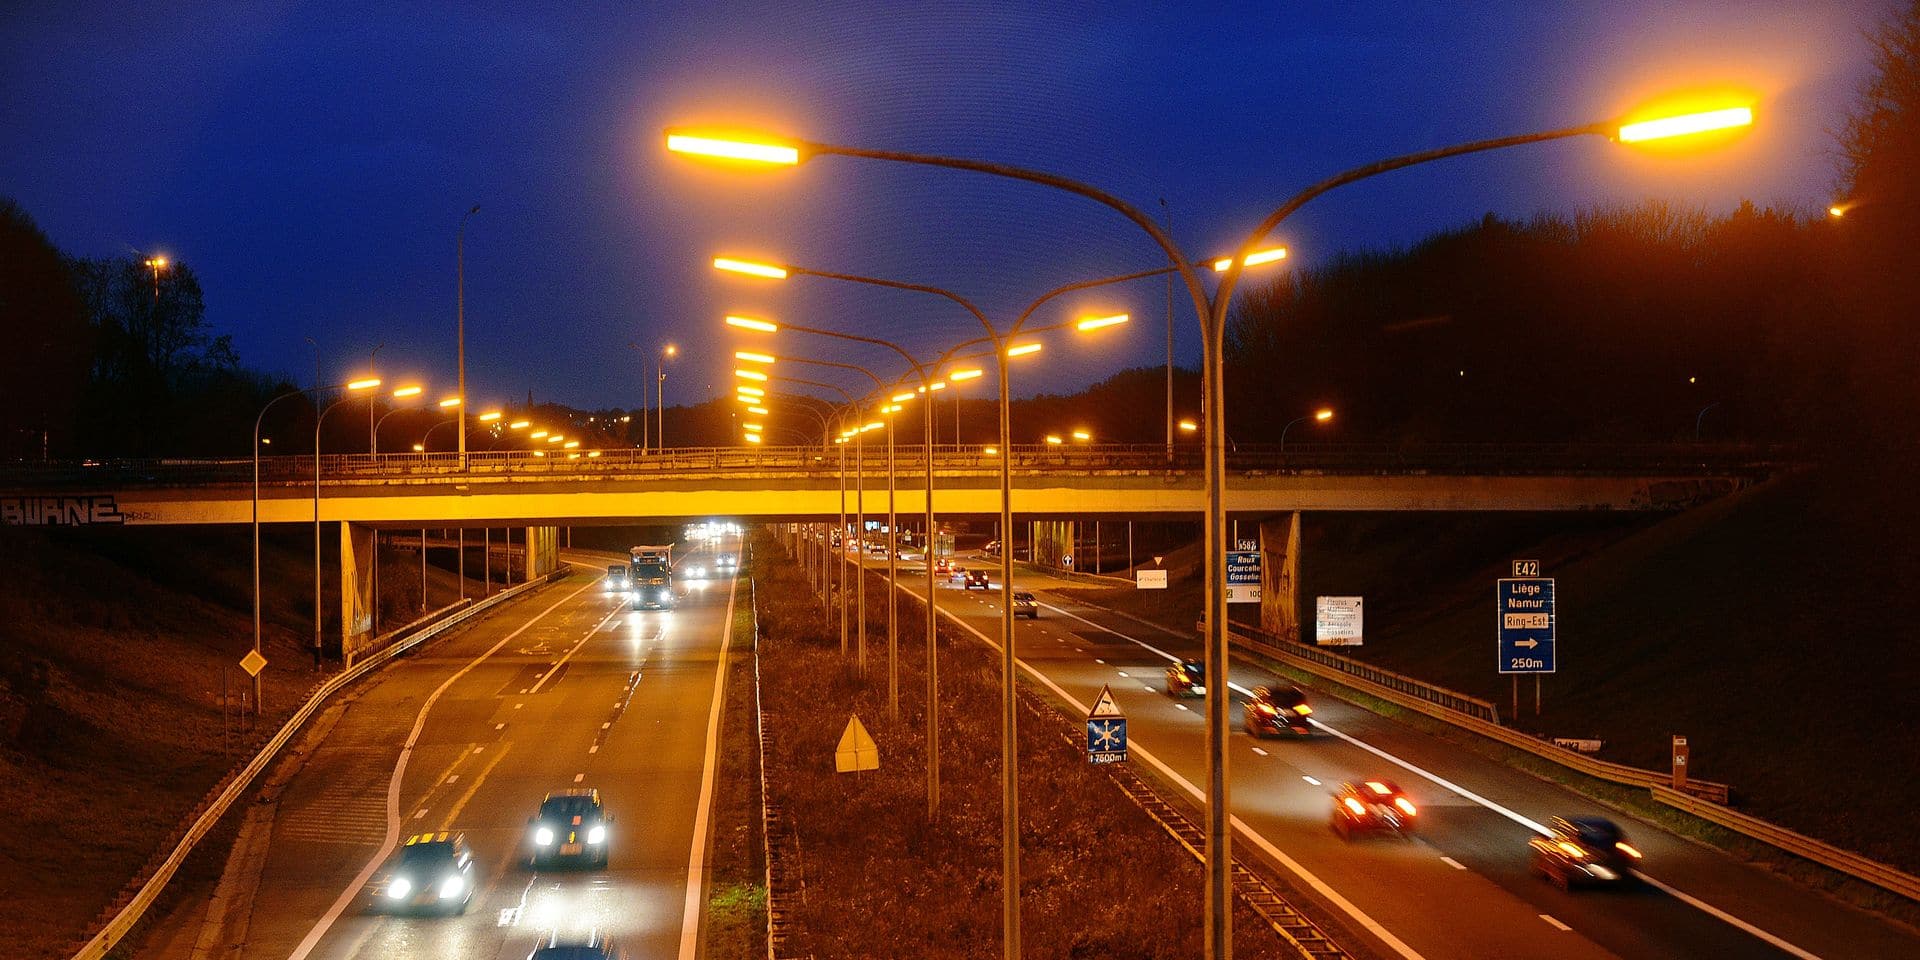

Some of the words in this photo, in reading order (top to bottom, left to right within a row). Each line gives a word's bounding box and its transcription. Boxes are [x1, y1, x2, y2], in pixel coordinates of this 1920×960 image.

[1237, 555, 1255, 563] Roux
[1227, 564, 1261, 572] Courcelle
[1515, 562, 1537, 576] E42
[1230, 573, 1260, 581] Gosselie
[1511, 583, 1540, 596] Liège
[1508, 598, 1544, 609] Namur
[1507, 616, 1546, 628] Ring-Est
[1511, 658, 1543, 668] 250m
